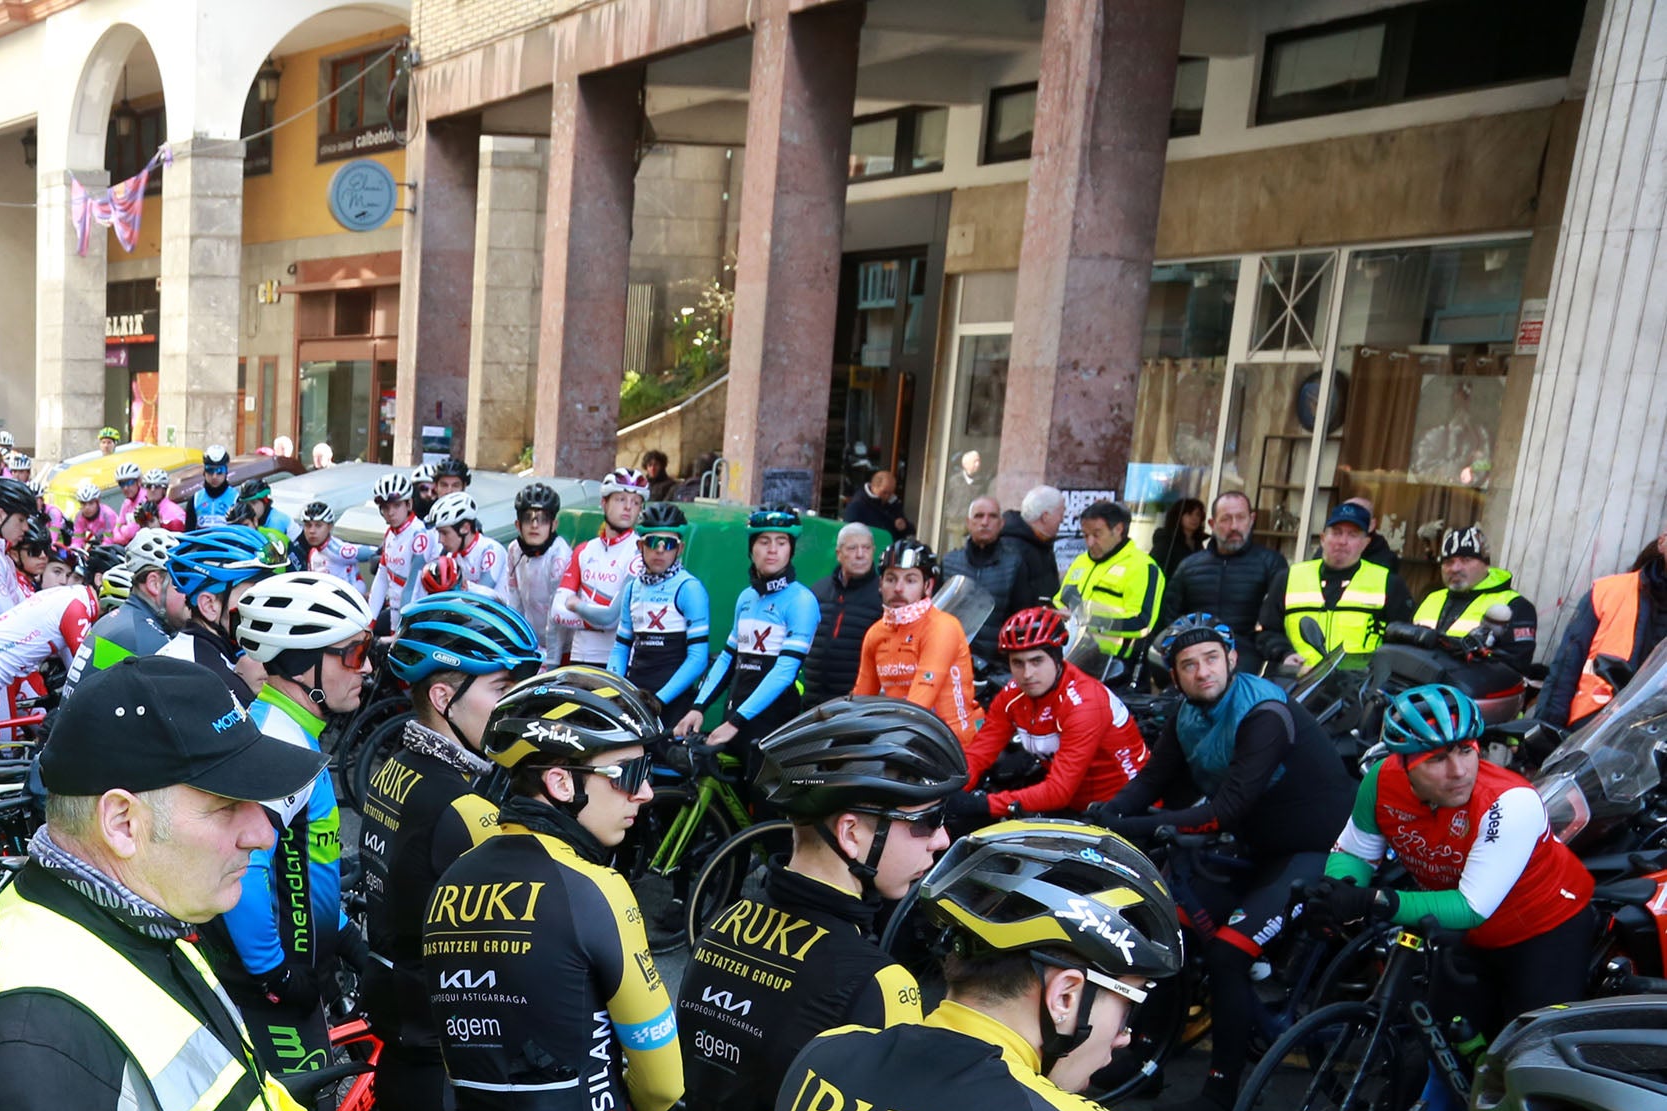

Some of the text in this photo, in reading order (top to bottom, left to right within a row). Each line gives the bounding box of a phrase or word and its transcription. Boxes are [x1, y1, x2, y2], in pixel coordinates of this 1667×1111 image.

[592, 571, 617, 584] AMPO
[435, 652, 459, 666] ABUS
[949, 665, 969, 731] ORBEA
[521, 721, 585, 751] Spiuk
[425, 880, 546, 928] IRUKI
[709, 897, 831, 962] IRUKI
[1054, 898, 1135, 965] Spiuk
[423, 939, 532, 956] DASTATZEN GROUP
[751, 966, 793, 992] GROUP
[1113, 982, 1131, 995] uvex
[462, 992, 528, 1005] ASTIGARRAGA
[680, 999, 764, 1039] CAPDEQUI ASTIGARRAGA
